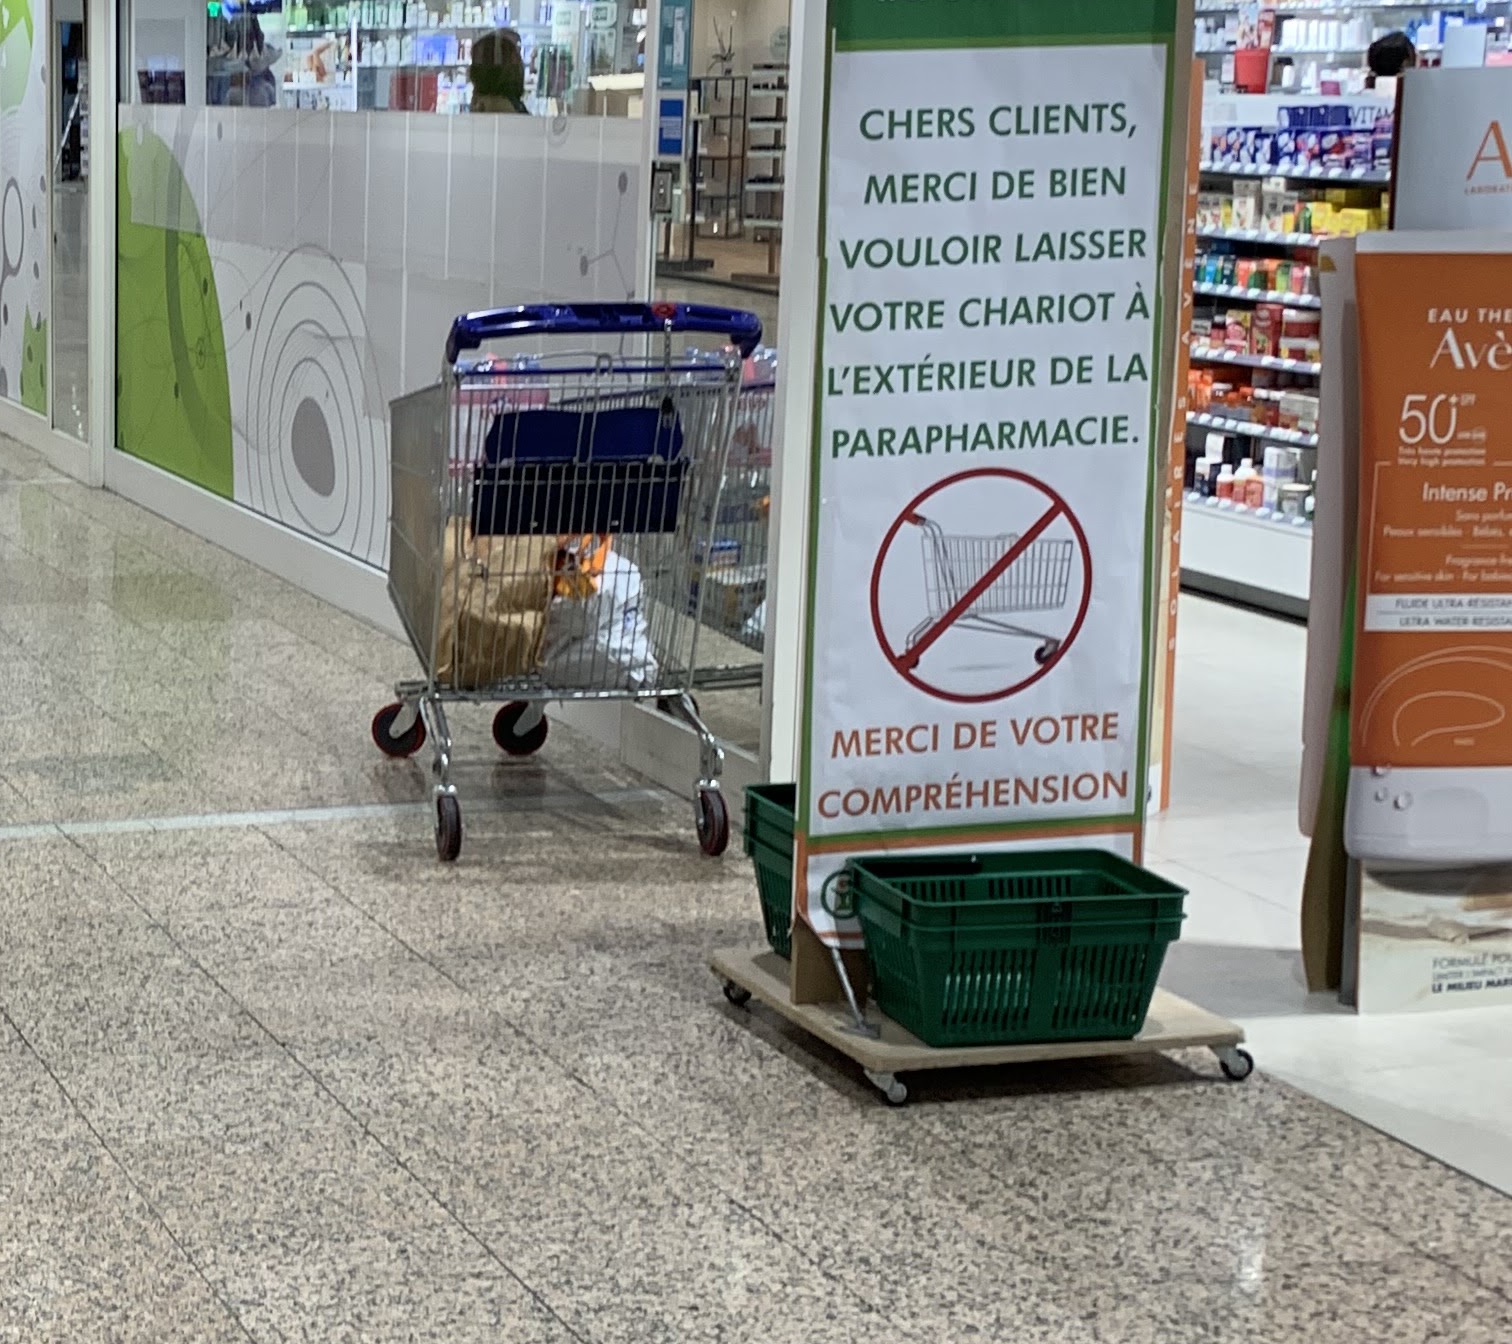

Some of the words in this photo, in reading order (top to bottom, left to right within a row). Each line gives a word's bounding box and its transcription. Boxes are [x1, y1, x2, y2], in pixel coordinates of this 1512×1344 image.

[859, 107, 976, 141] CHERS
[988, 102, 1138, 139] CLIENTS,
[864, 171, 978, 205] MERCI
[991, 169, 1035, 199] DE
[1049, 166, 1126, 198] BIEN
[839, 234, 1002, 269] VOULOIR
[1014, 228, 1147, 263] LAISSER
[829, 300, 945, 333] VOTRE
[958, 292, 1116, 328] CHARIOT
[1125, 282, 1151, 321] À
[1427, 307, 1469, 323] EAU
[1429, 327, 1512, 371] Avè
[827, 355, 1037, 397] L'EXTÉRIEUR
[1049, 355, 1094, 386] DE
[1107, 352, 1149, 384] LA
[830, 415, 1141, 459] PARAPHARMACIE.
[1422, 481, 1488, 503] Intense
[830, 724, 940, 759] MERCI
[953, 721, 997, 751] DE
[1010, 712, 1120, 746] VOTRE
[817, 770, 1129, 820] COMPRÉHENSION
